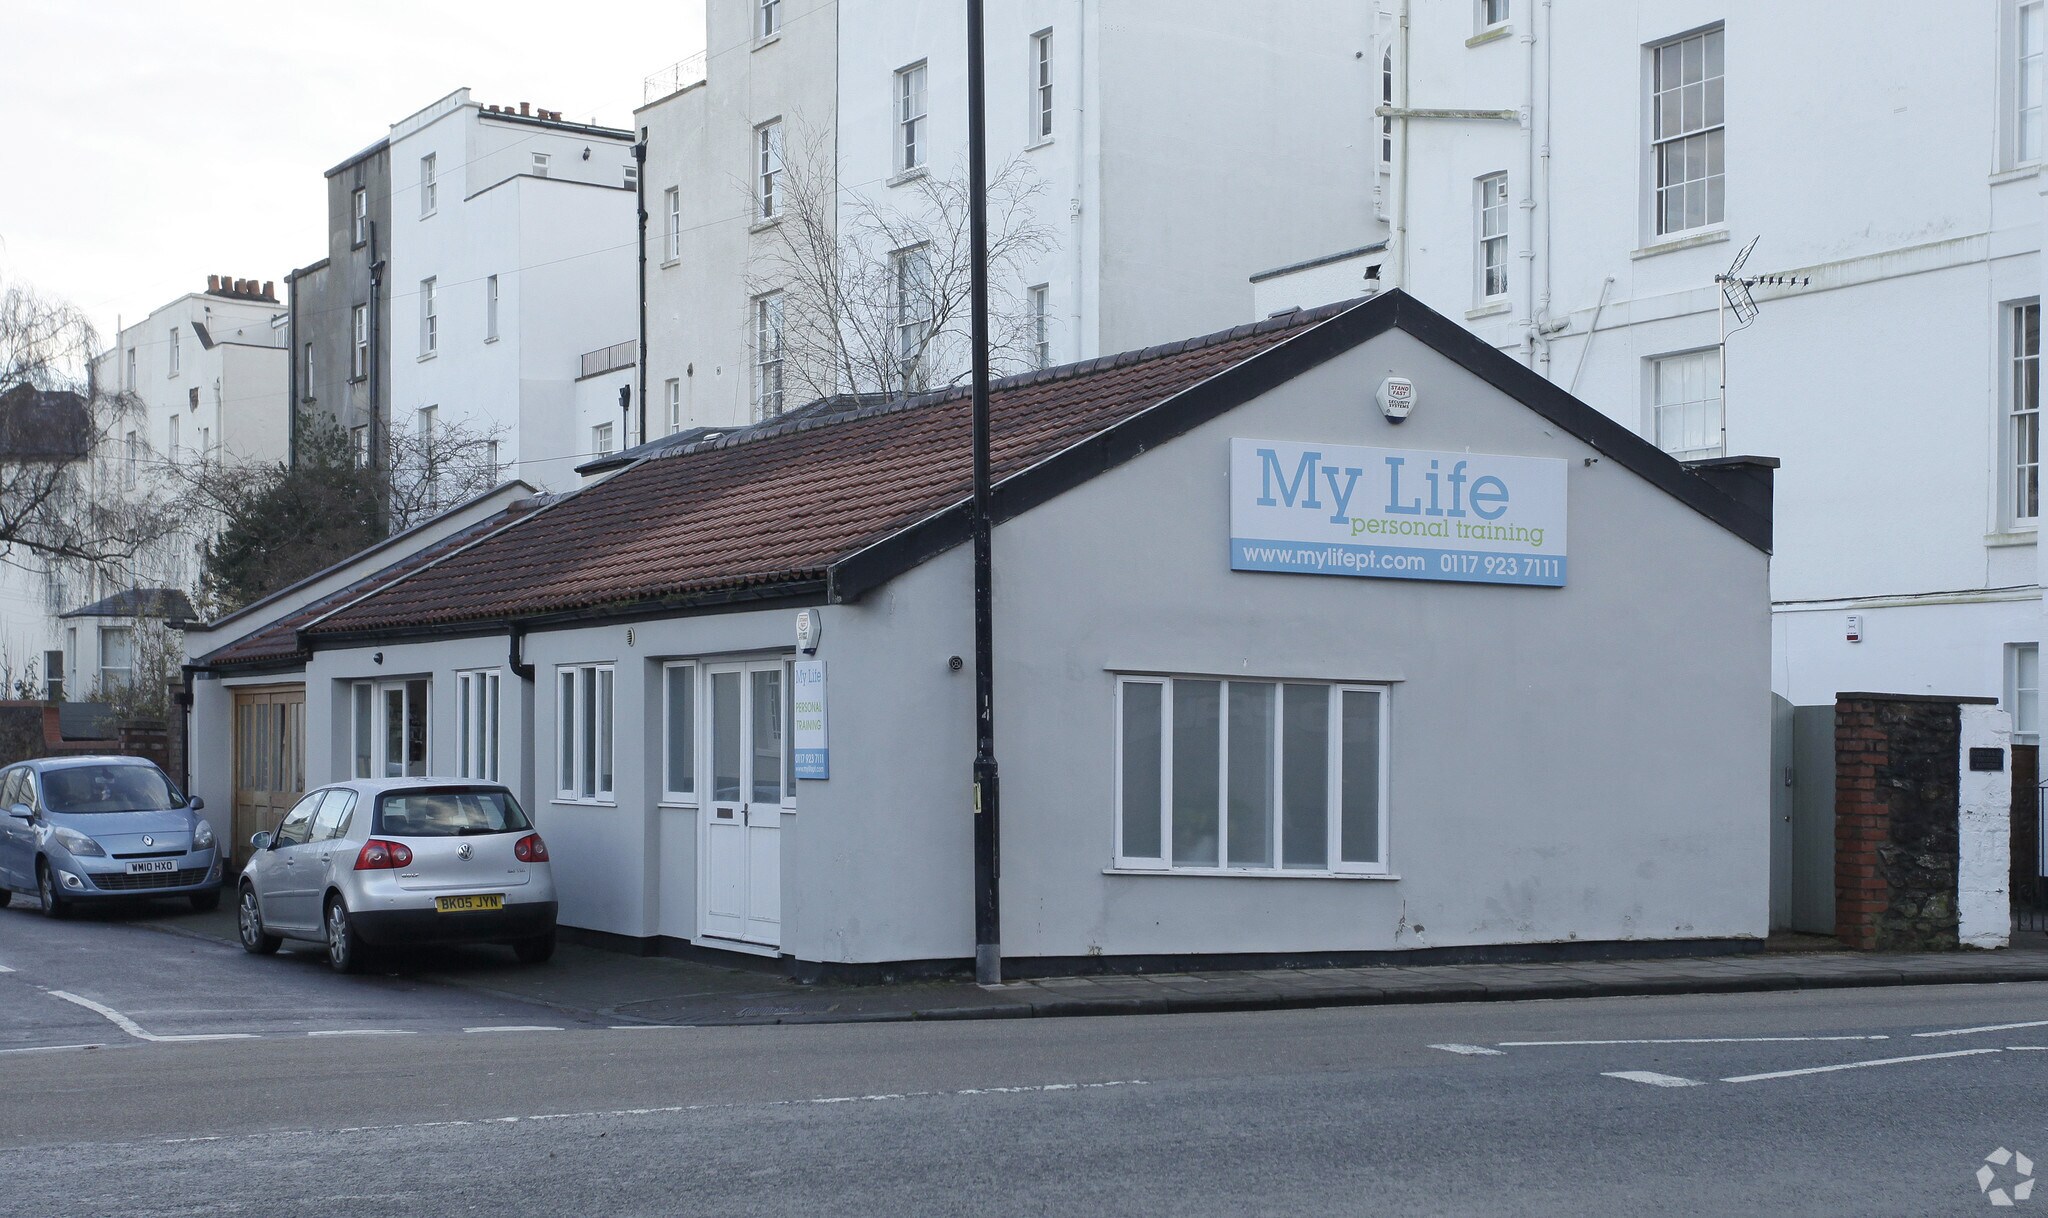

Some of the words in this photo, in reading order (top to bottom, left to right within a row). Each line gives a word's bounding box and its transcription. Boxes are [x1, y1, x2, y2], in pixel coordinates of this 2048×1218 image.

[1256, 448, 1363, 525] My
[1384, 456, 1510, 521] Life
[1350, 517, 1450, 537] personal
[1456, 519, 1545, 547] training
[1243, 547, 1425, 572] www.mylifept.com
[1440, 554, 1478, 574] 0117
[1484, 556, 1518, 576] 923
[1523, 558, 1559, 577] 7111
[796, 669, 806, 686] My
[808, 669, 822, 683] Life
[796, 701, 822, 712] PERSONAL
[797, 719, 822, 730] TRAINING
[131, 862, 153, 872] WM10
[154, 861, 173, 871] HXO
[441, 898, 473, 910] BK05
[476, 896, 498, 908] JYN
